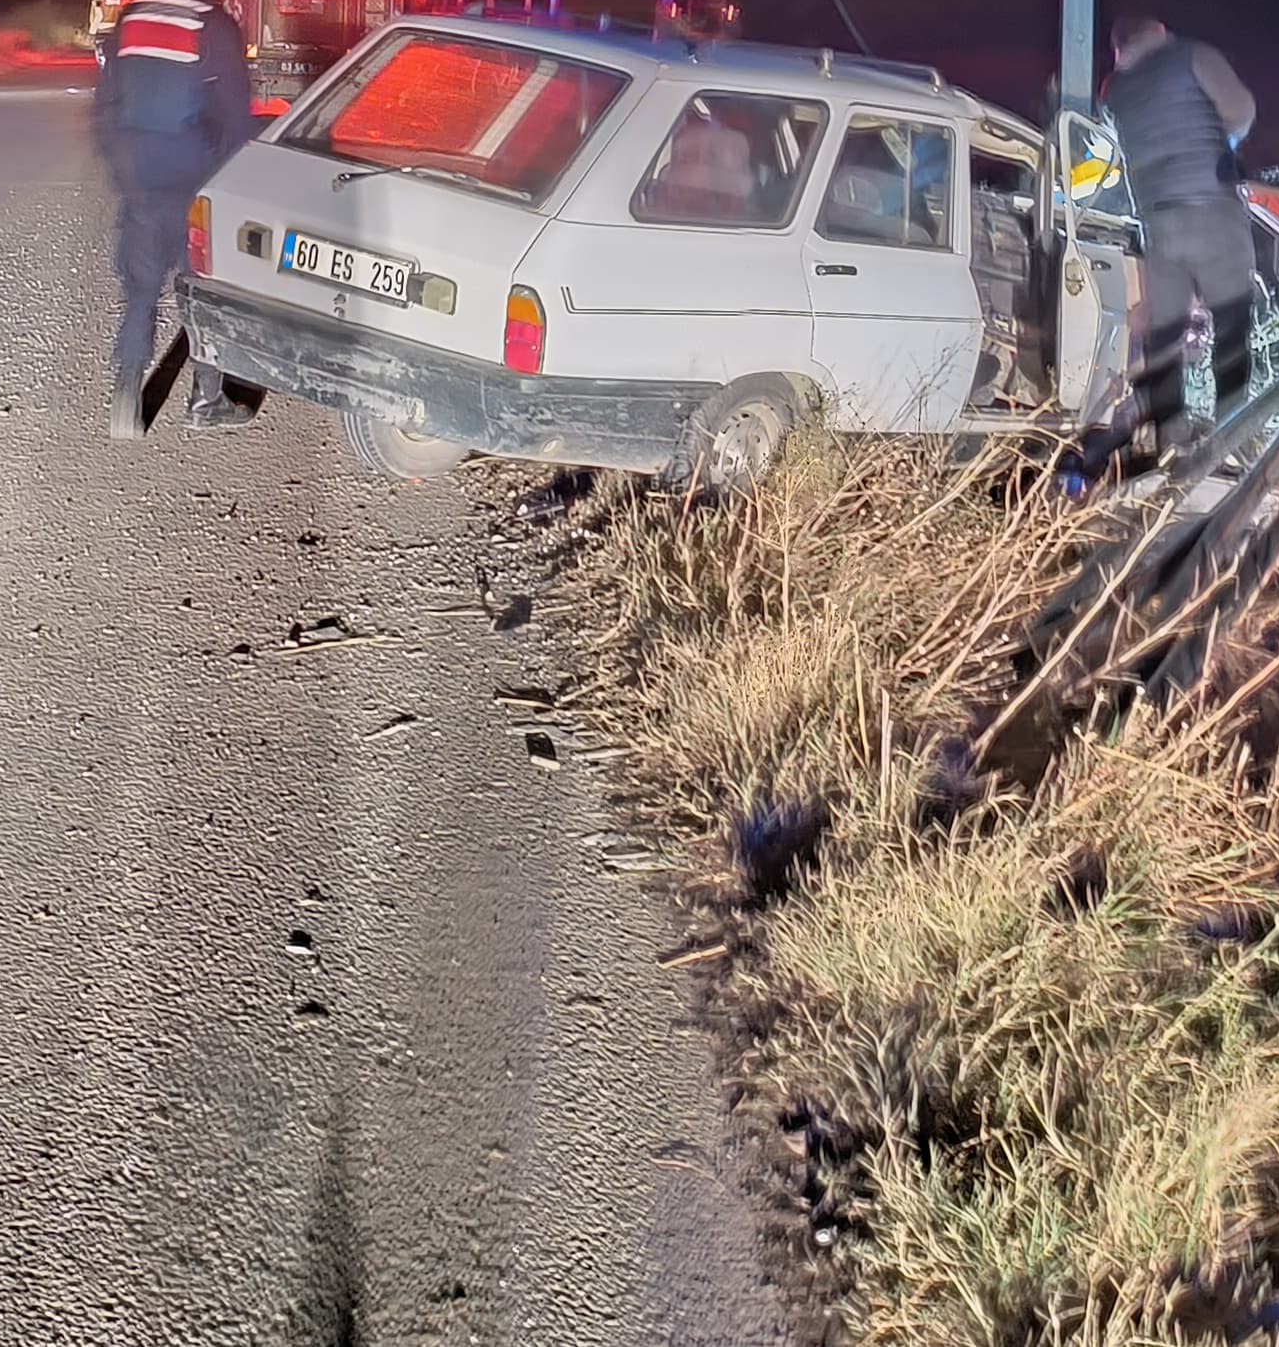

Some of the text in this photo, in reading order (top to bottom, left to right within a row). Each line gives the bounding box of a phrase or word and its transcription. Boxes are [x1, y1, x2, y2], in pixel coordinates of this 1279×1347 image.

[297, 240, 405, 296] 60 ES 259
